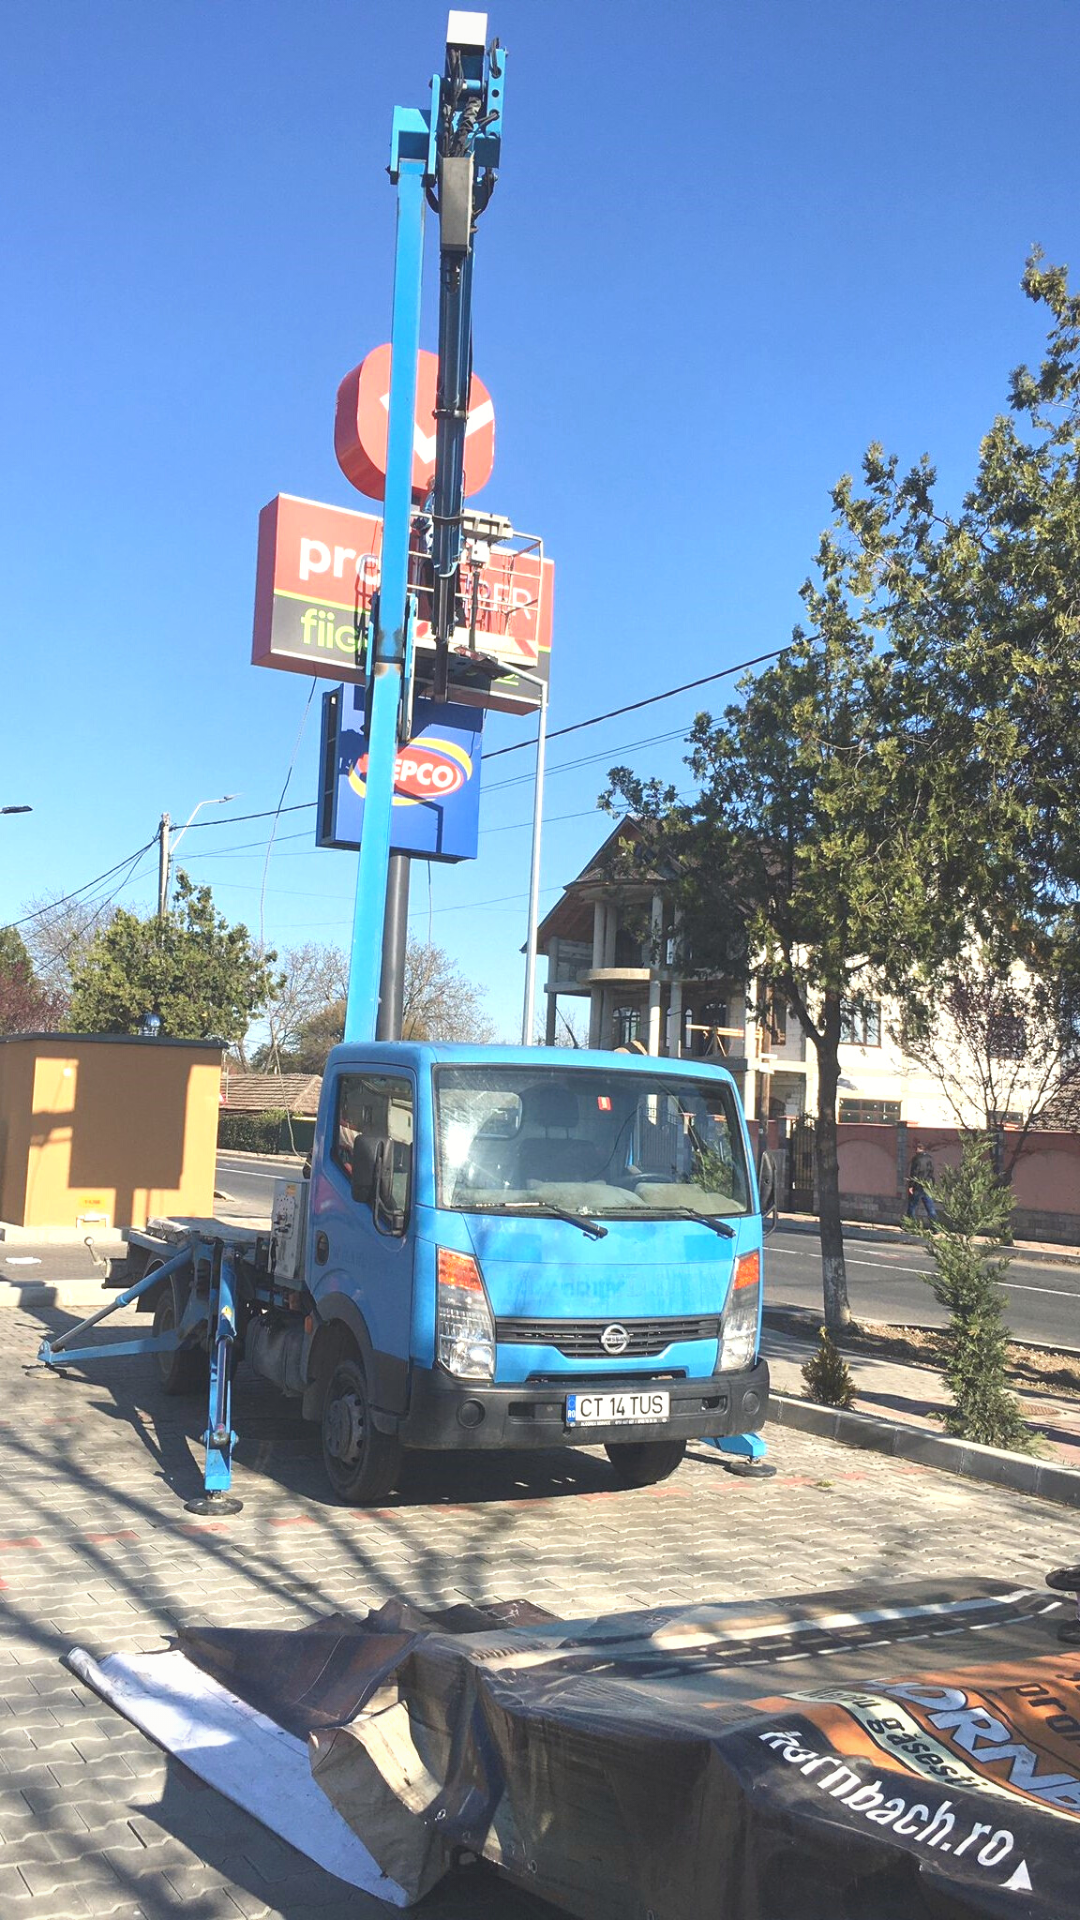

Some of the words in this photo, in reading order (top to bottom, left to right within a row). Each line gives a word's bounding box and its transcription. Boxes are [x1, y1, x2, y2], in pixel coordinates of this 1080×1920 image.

[394, 757, 454, 789] EPCO
[567, 1409, 576, 1418] RO
[580, 1397, 603, 1417] CT
[610, 1396, 625, 1416] 14
[630, 1395, 663, 1415] TUS
[758, 1731, 1014, 1867] hornbach.ro
